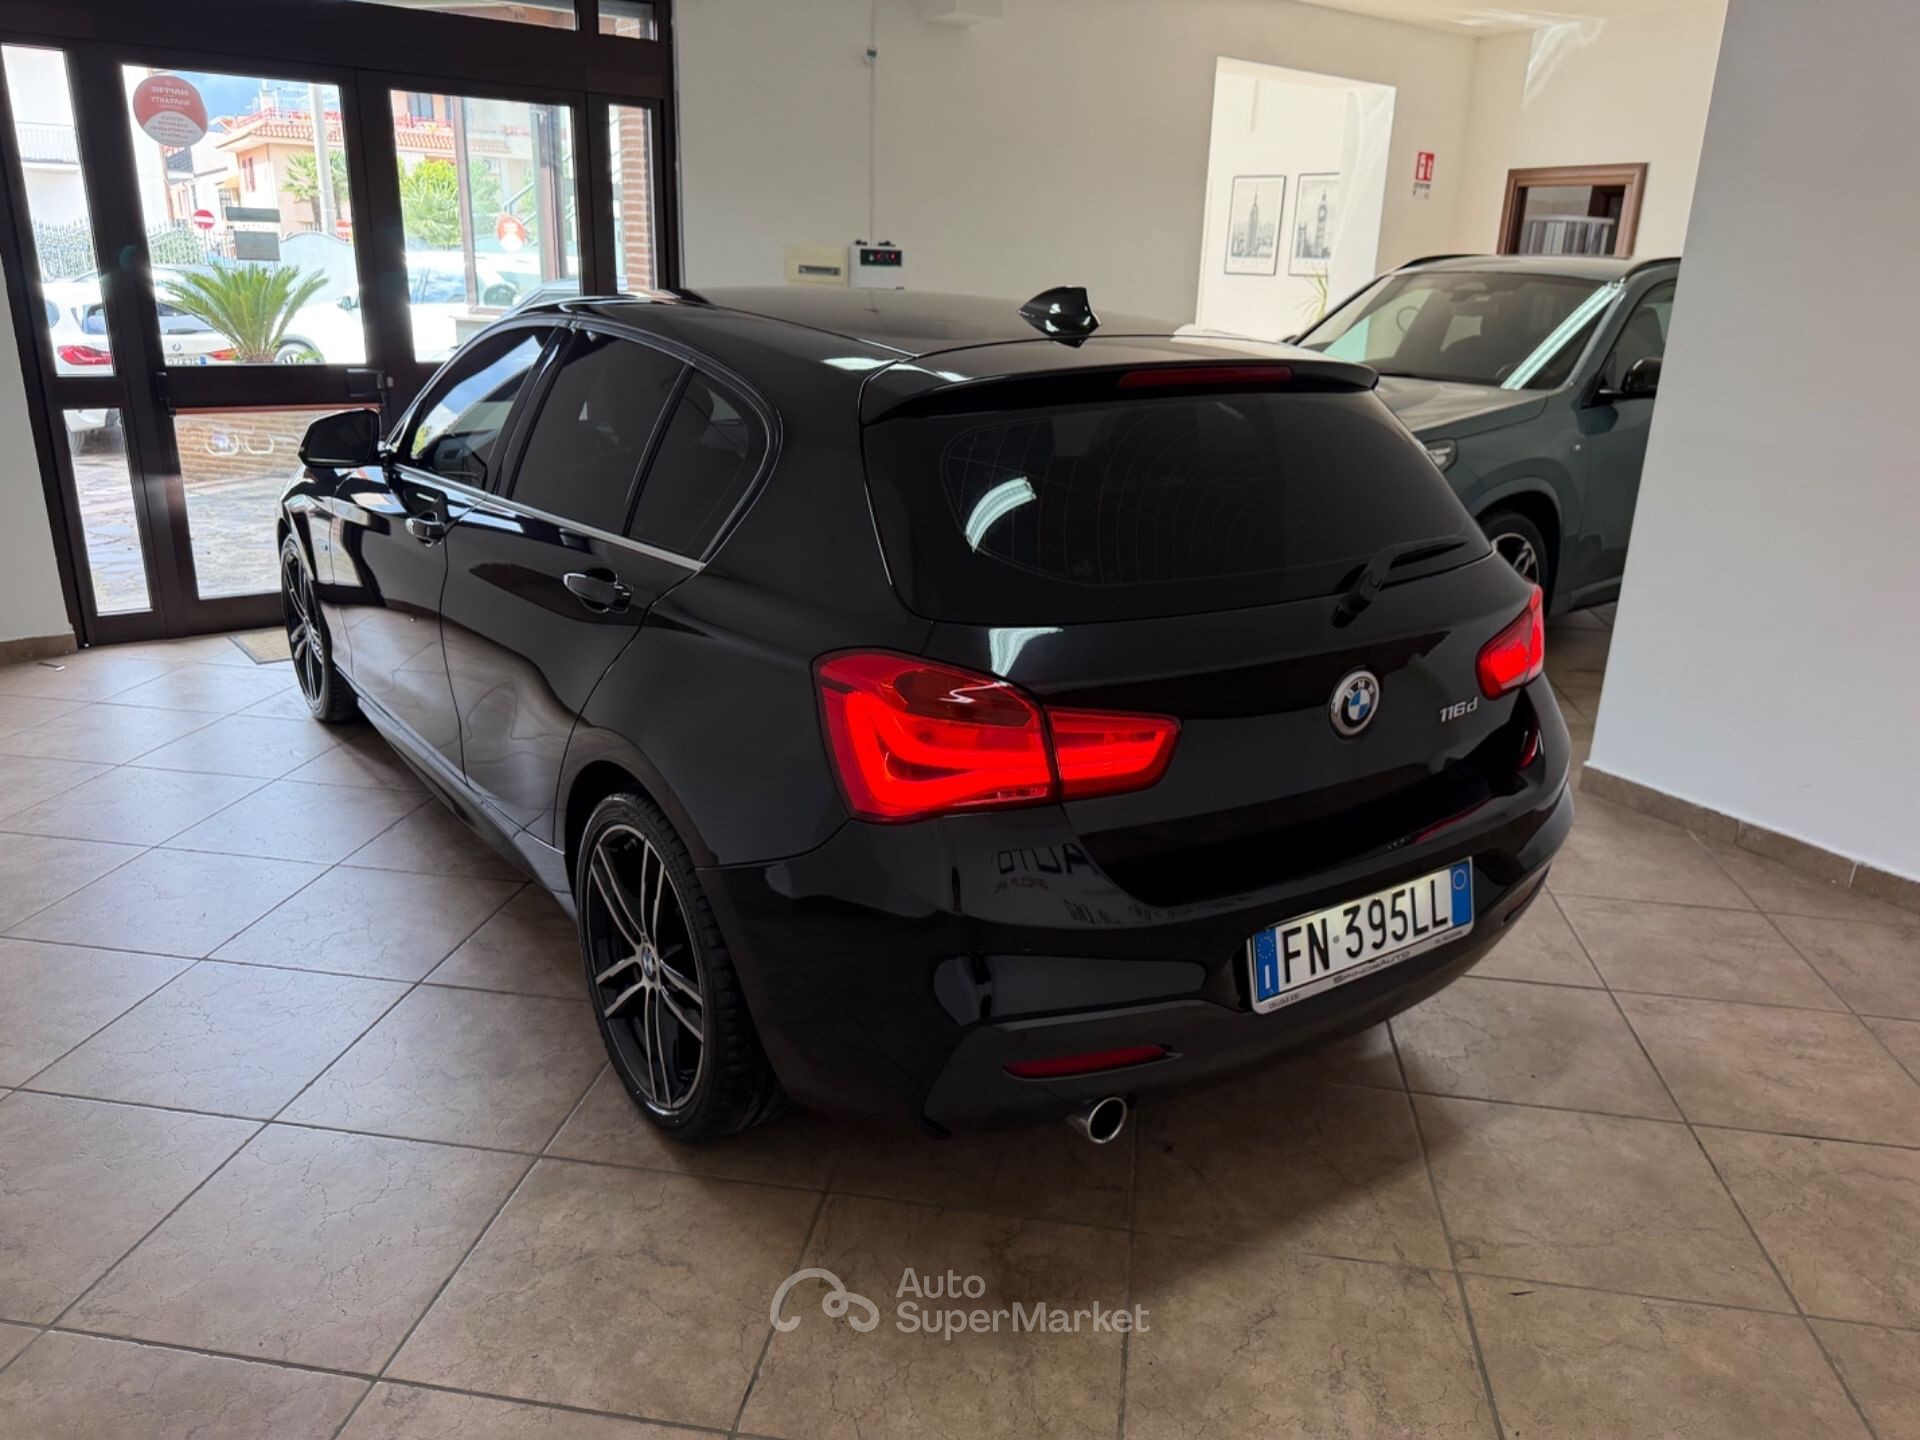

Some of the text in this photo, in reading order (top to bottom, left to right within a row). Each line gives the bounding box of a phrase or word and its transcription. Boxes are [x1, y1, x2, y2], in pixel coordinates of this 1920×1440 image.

[1439, 696, 1479, 723] 116d
[1281, 879, 1448, 985] FN 395LL
